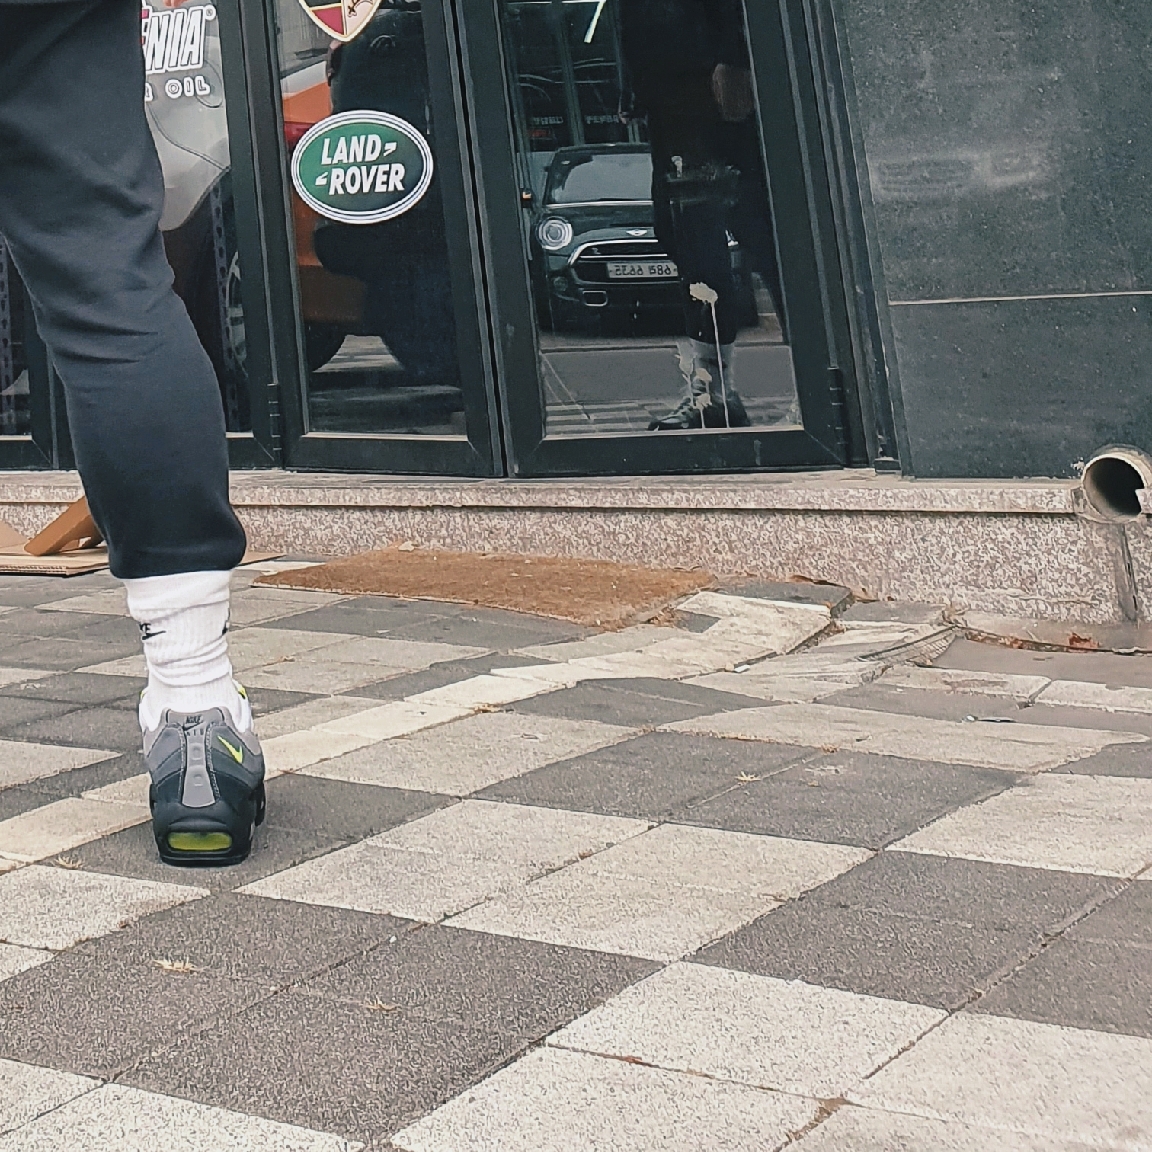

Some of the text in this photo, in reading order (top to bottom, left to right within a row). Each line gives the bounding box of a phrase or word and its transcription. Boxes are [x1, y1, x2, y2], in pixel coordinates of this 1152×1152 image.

[142, 7, 206, 76] NIA
[165, 75, 211, 99] OIL
[329, 163, 406, 195] ROVER
